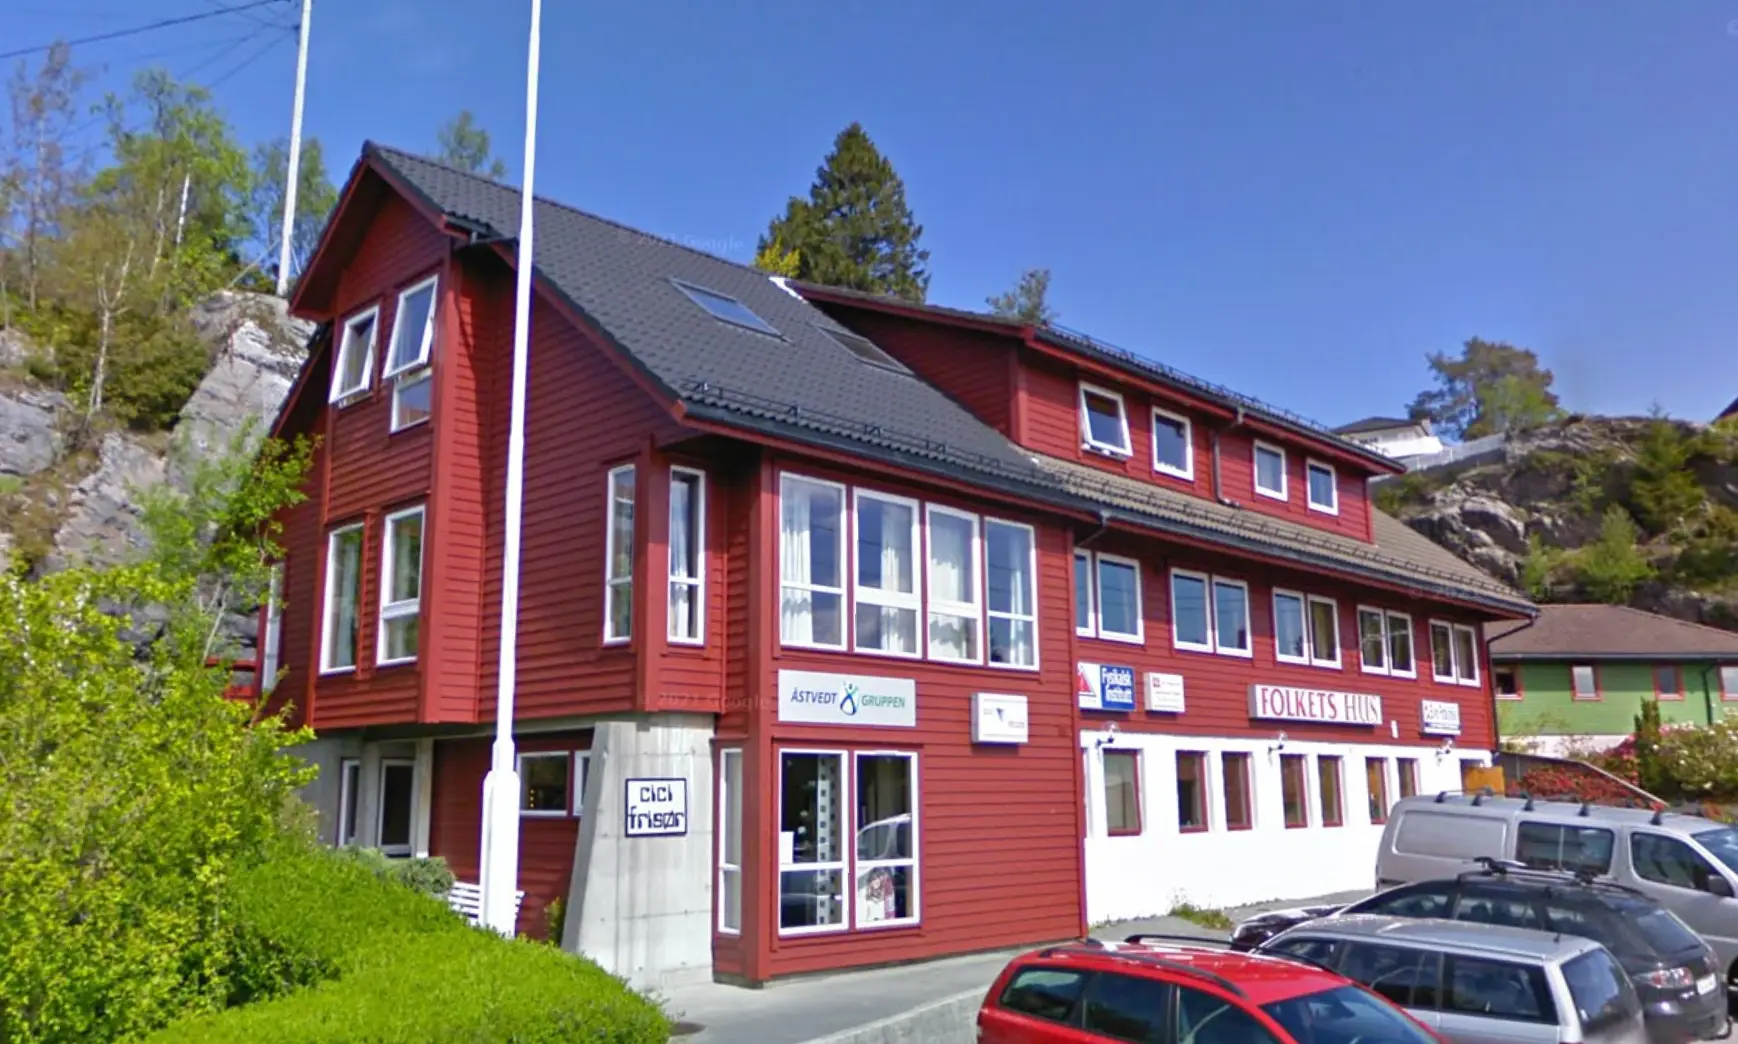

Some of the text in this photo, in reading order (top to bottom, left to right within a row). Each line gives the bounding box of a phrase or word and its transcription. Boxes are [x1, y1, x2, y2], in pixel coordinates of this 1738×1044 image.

[791, 687, 906, 708] ÅSTVEDT GRUPPEN
[1261, 687, 1379, 722] FOLKETS HUS
[640, 784, 673, 802] cici
[628, 805, 684, 829] frisør
